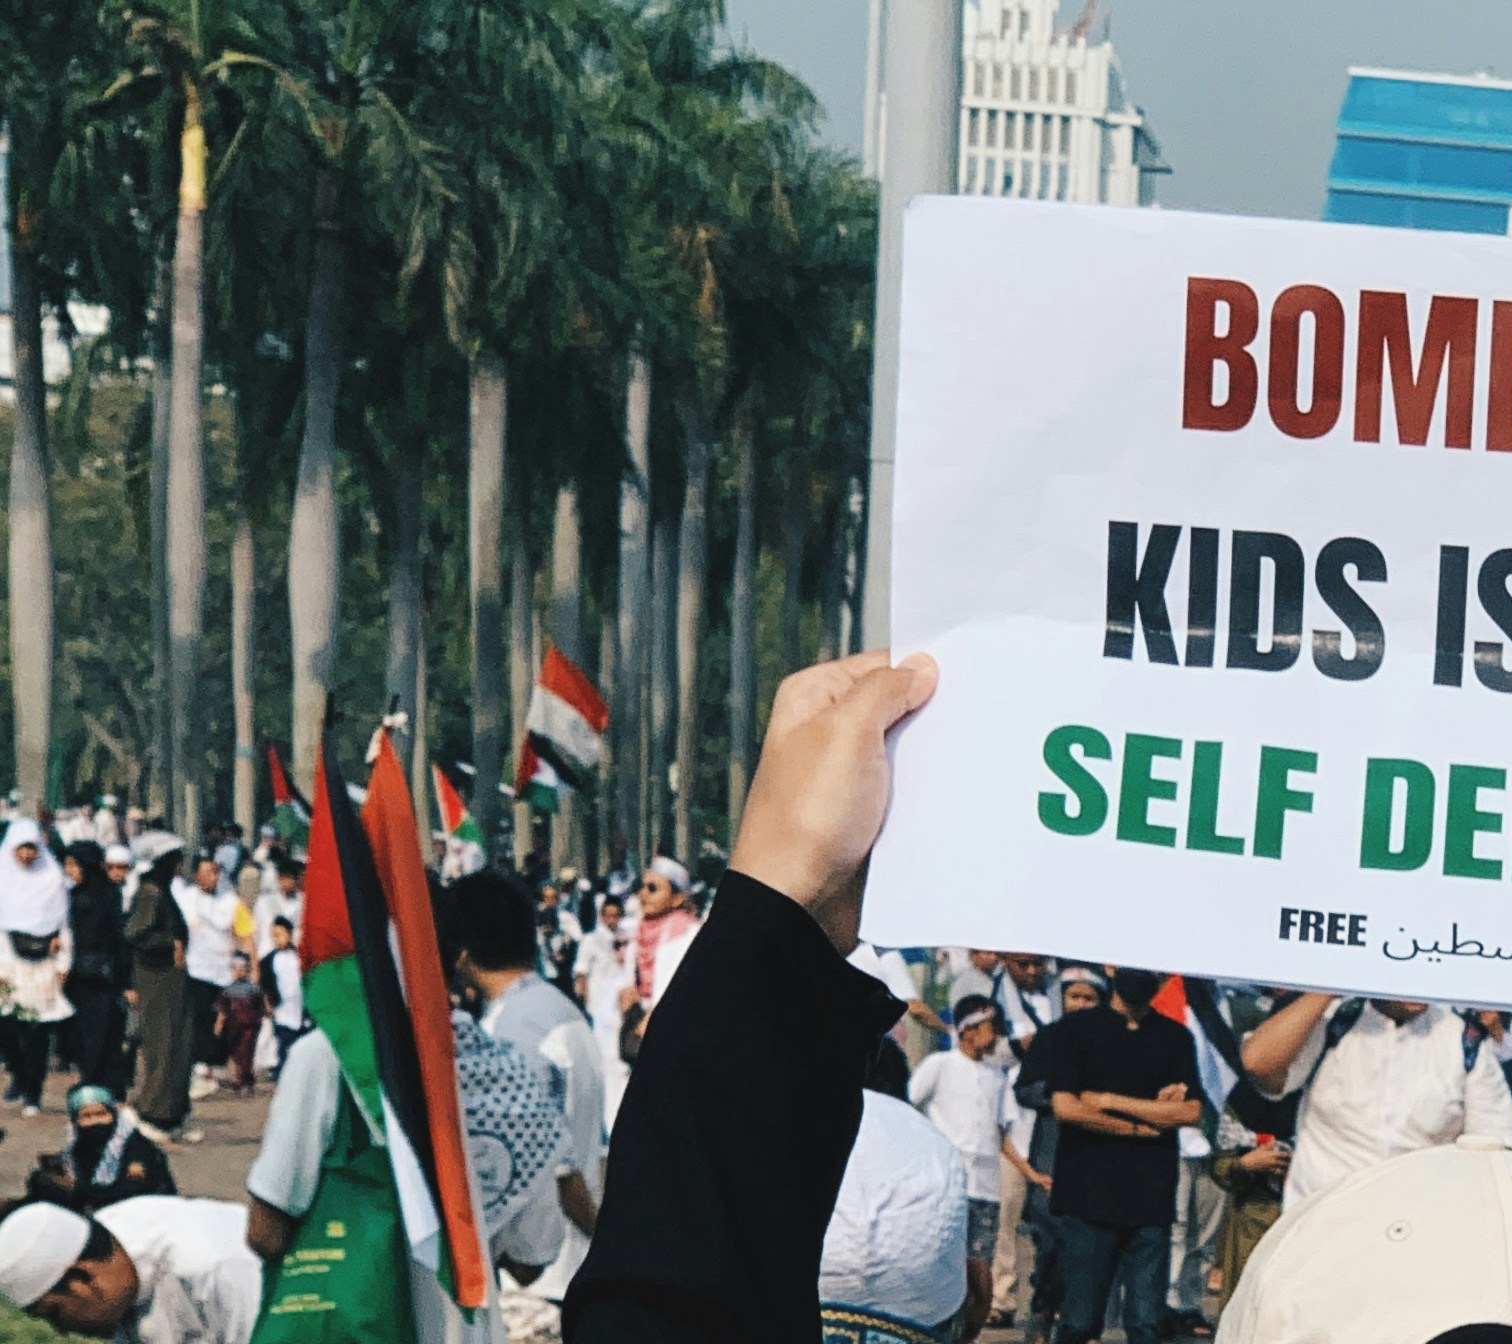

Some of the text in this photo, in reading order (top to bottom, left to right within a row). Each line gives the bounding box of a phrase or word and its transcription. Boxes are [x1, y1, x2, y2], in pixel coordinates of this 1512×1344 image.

[1102, 520, 1388, 681] KIDS
[1037, 724, 1318, 859] SELF
[1278, 906, 1368, 948] FREE
